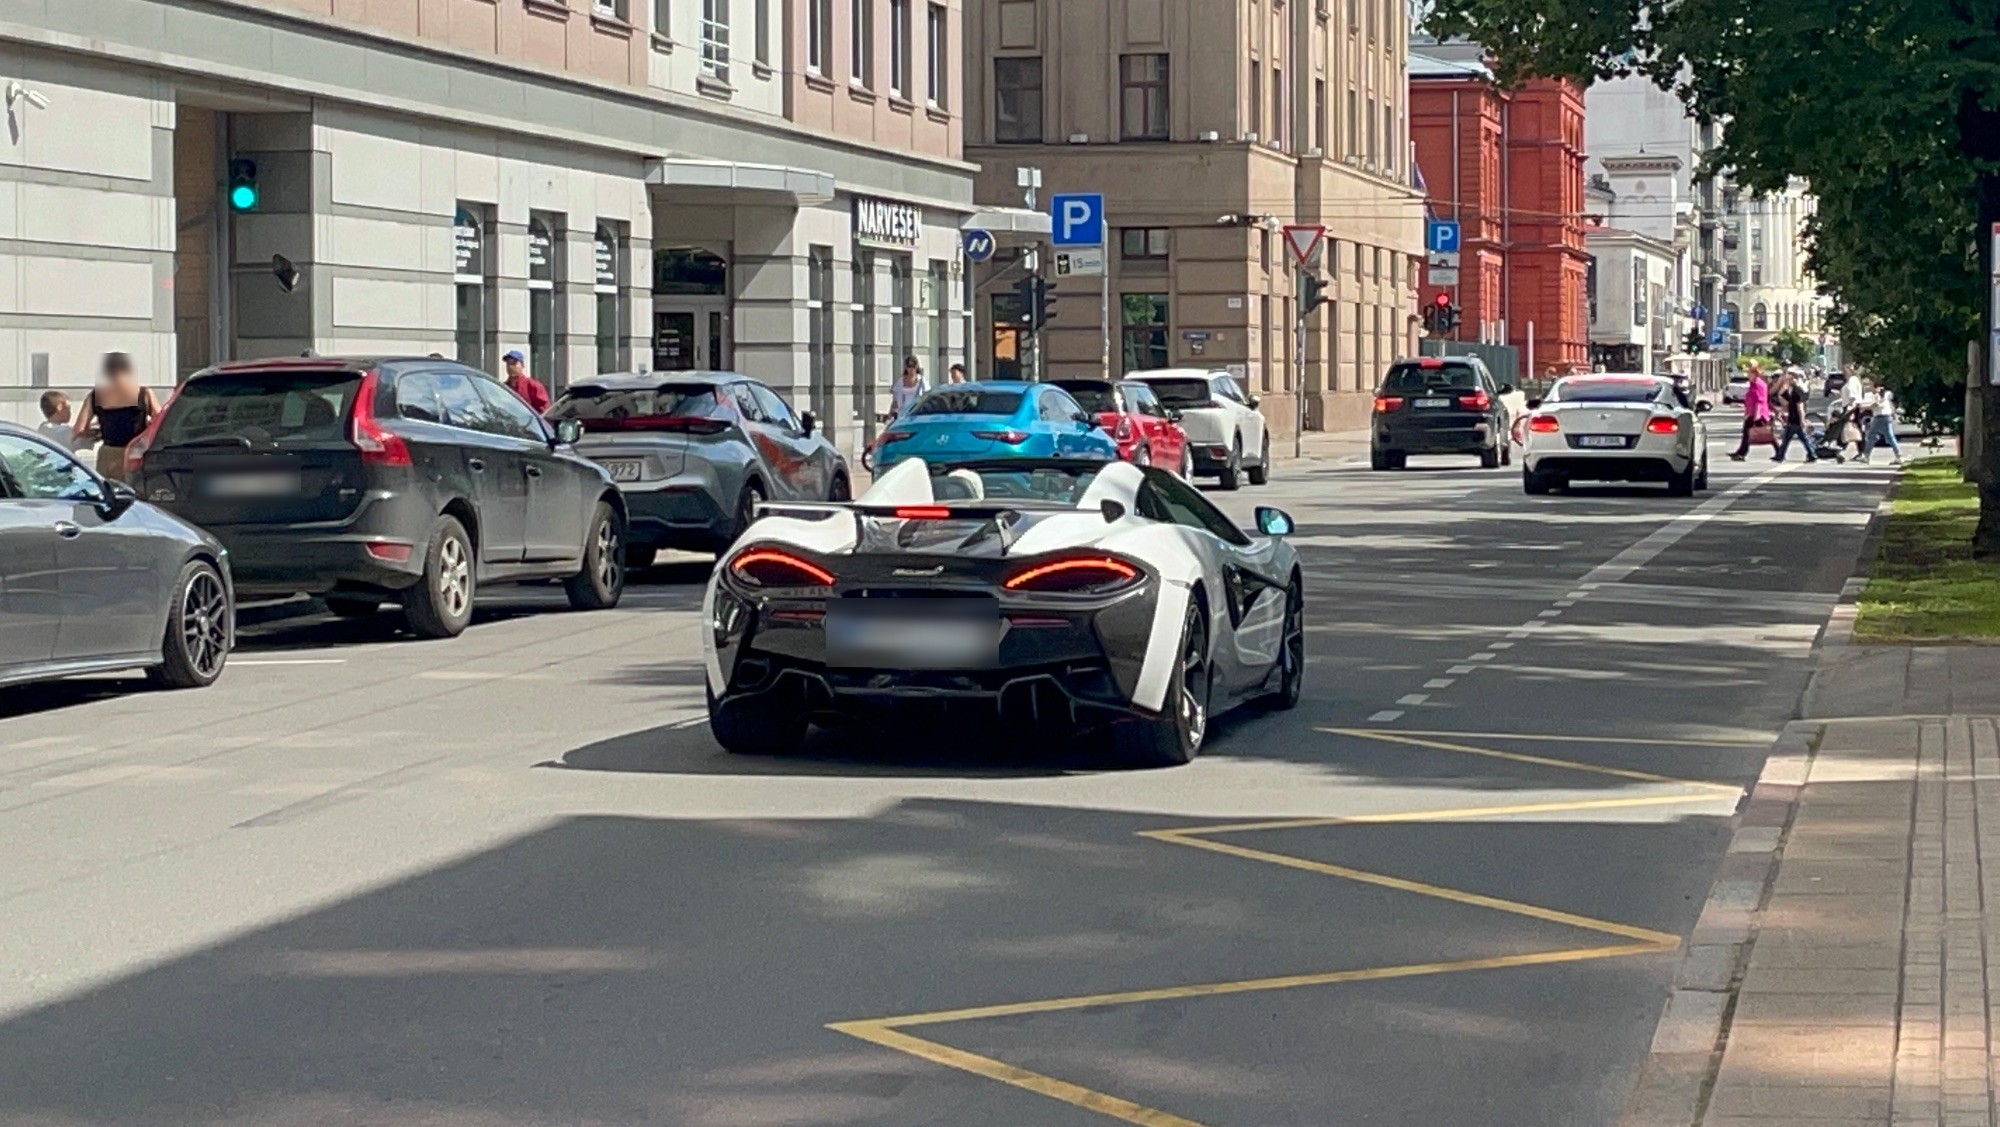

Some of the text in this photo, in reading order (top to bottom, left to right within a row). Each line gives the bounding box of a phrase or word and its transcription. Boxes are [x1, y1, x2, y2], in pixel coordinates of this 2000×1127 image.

[858, 198, 922, 239] NARVESEN
[1063, 200, 1091, 239] P
[1436, 226, 1453, 250] P
[1711, 332, 1720, 342] P
